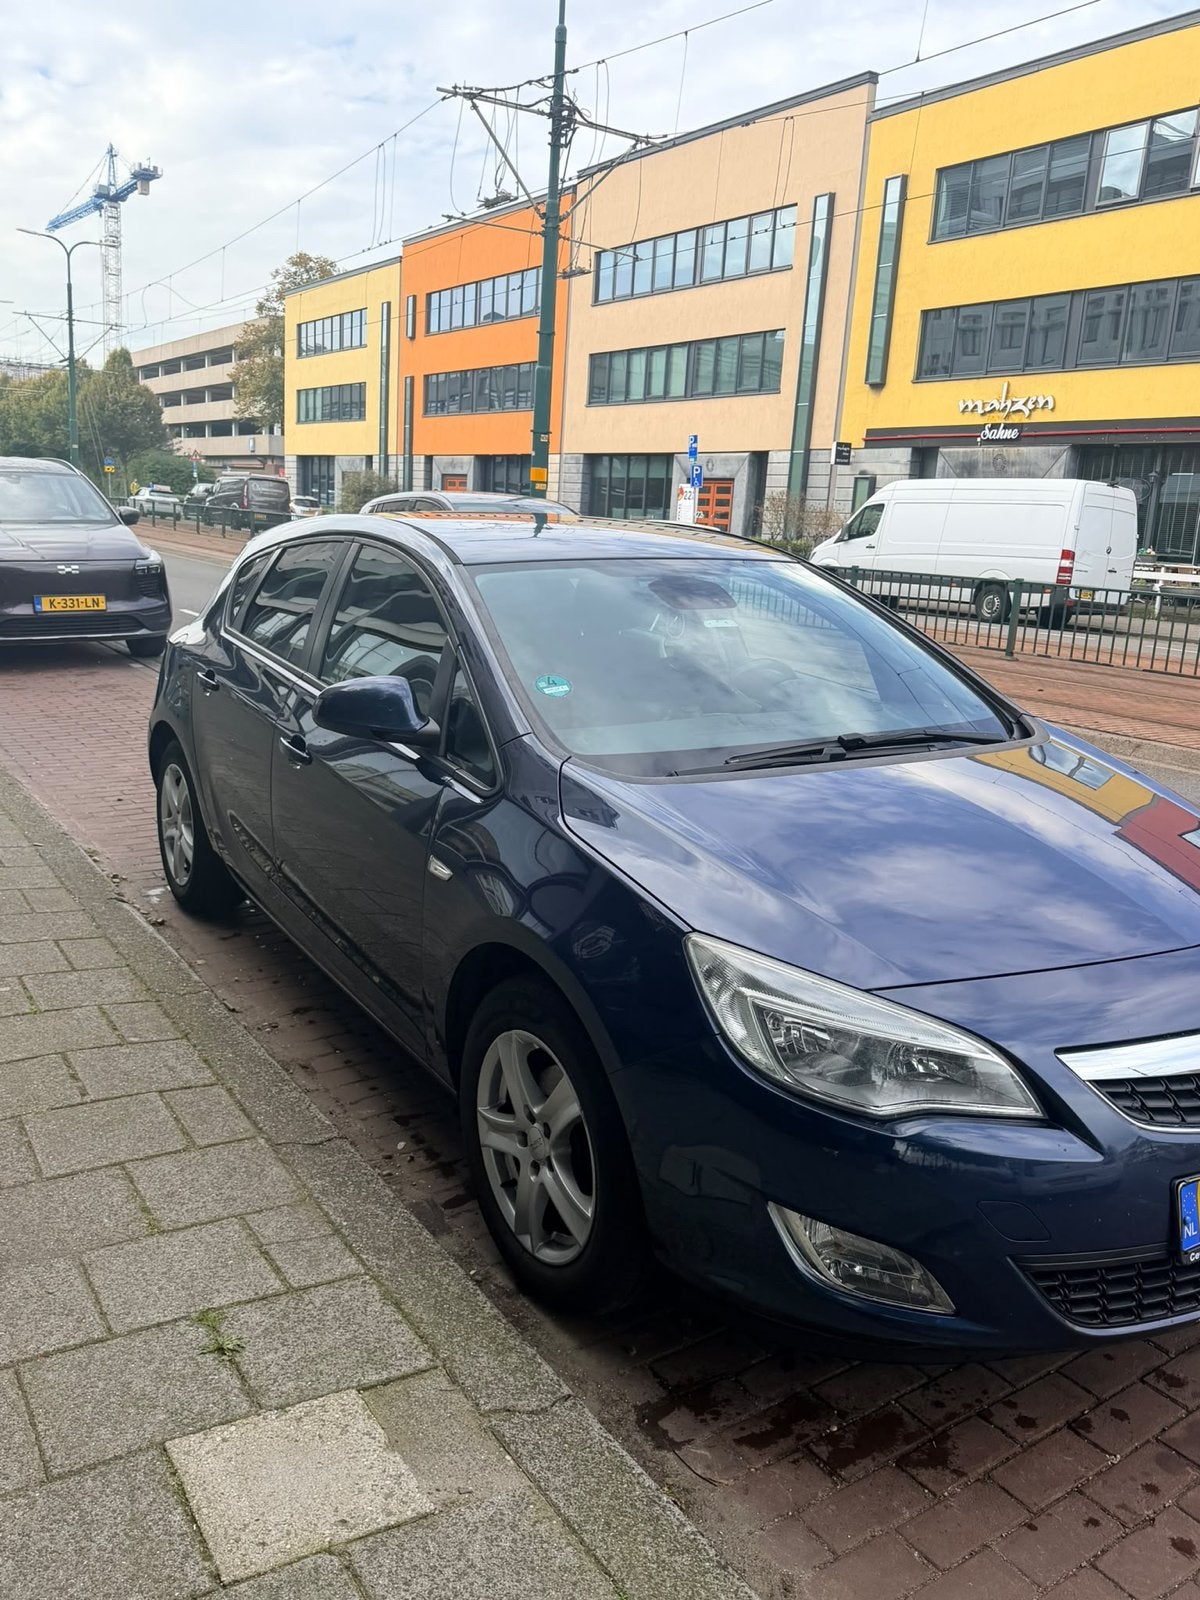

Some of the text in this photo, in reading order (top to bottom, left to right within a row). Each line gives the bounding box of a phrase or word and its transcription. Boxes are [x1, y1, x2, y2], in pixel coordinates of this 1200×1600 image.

[959, 381, 1054, 418] mahzen
[981, 423, 1019, 440] Sahne
[693, 466, 701, 478] P
[49, 597, 100, 609] K-331-LN
[1184, 1222, 1198, 1239] NL
